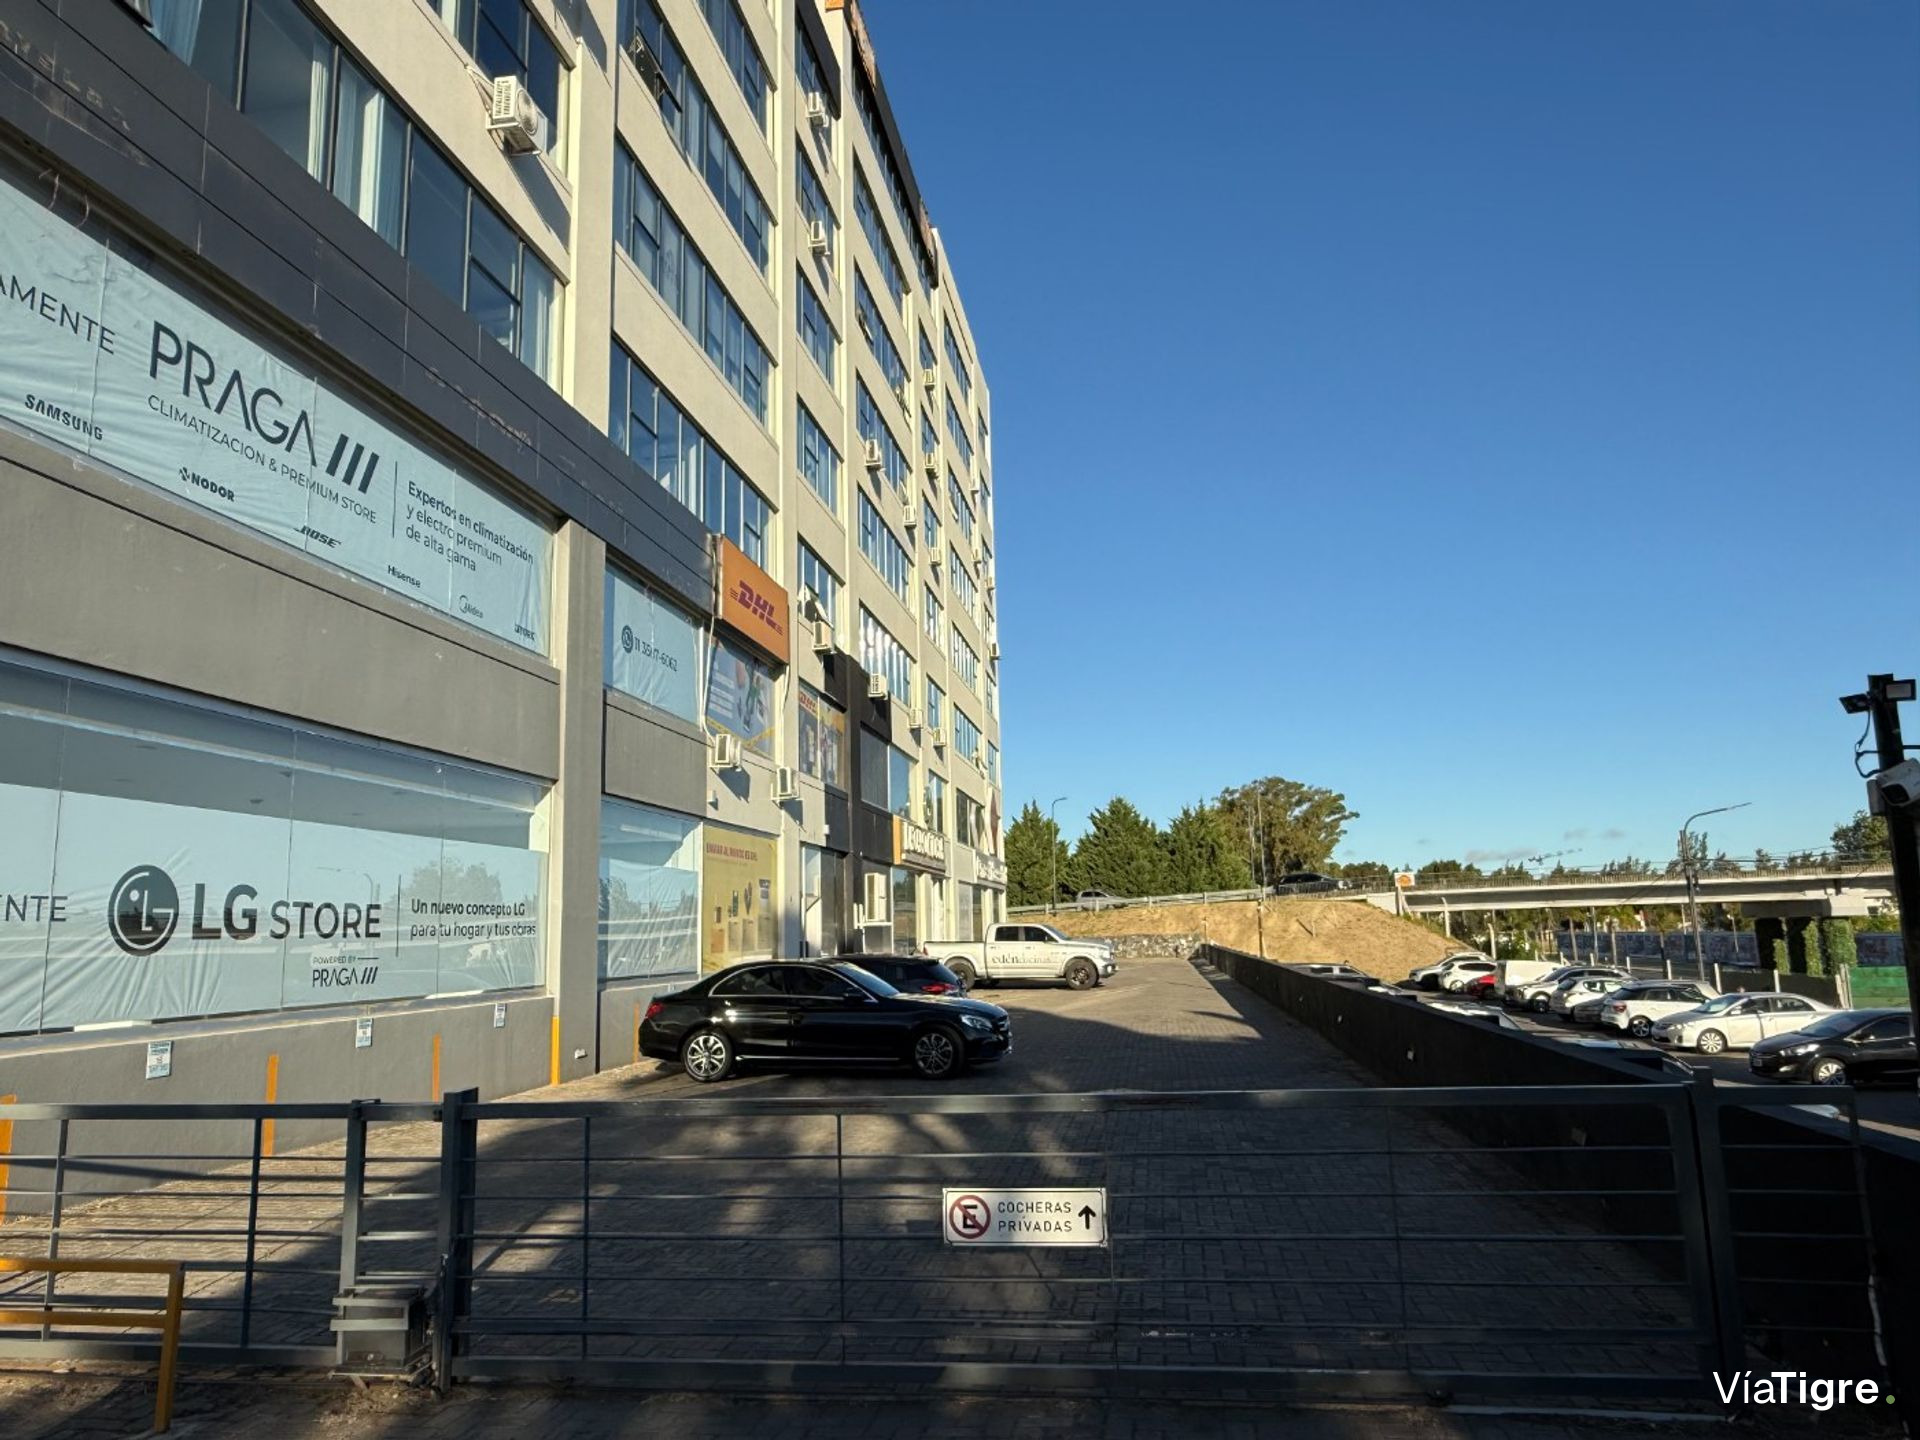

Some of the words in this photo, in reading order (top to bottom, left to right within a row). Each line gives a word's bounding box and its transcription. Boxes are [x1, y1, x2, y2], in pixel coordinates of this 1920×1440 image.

[149, 320, 318, 467] PRAGA
[24, 393, 103, 441] SAMSUNG
[148, 394, 265, 466] CLIMATIZACION
[268, 458, 277, 472] &
[281, 464, 339, 504] PREMIUM
[341, 496, 377, 524] STORE
[191, 472, 235, 501] NODOR
[406, 504, 414, 520] y
[416, 508, 455, 539] electro
[456, 532, 502, 566] premium
[408, 480, 457, 520] Expertos
[458, 513, 472, 526] en
[473, 520, 534, 565] climatización
[406, 524, 421, 542] de
[424, 535, 444, 556] alta
[446, 547, 476, 571] gama
[737, 579, 777, 628] DHL
[0, 894, 69, 922] NTE
[192, 883, 258, 941] LG
[269, 898, 381, 940] STORE
[411, 898, 428, 915] Un
[430, 900, 464, 916] nuevo
[466, 902, 513, 919] concepto
[513, 903, 526, 916] LG
[410, 924, 436, 941] para
[438, 922, 452, 937] tu
[453, 920, 486, 940] hogar
[486, 925, 493, 940] y
[494, 921, 510, 937] tus
[511, 921, 536, 937] obras
[312, 956, 347, 965] POWERED
[312, 967, 358, 988] PRAGA
[997, 1201, 1072, 1214] COCHERAS
[998, 1220, 1073, 1233] PRIVADAS
